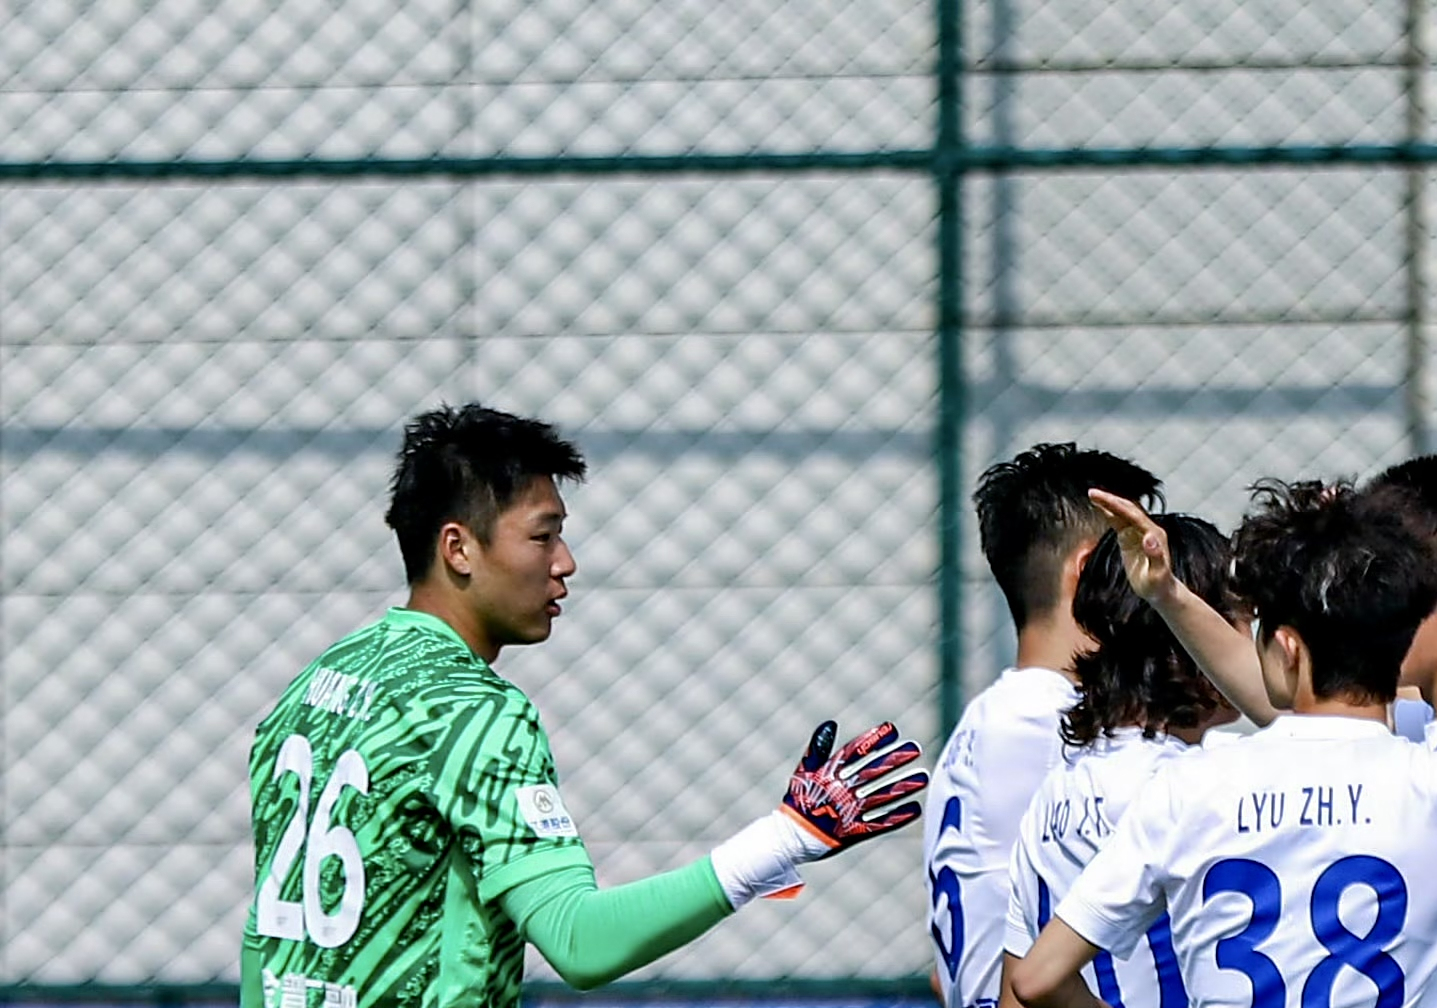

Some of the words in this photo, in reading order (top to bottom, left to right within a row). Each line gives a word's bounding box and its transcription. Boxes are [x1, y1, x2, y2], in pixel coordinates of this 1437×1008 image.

[256, 733, 368, 949] 26
[1238, 792, 1285, 833] LYU
[1300, 784, 1371, 826] ZH.Y.
